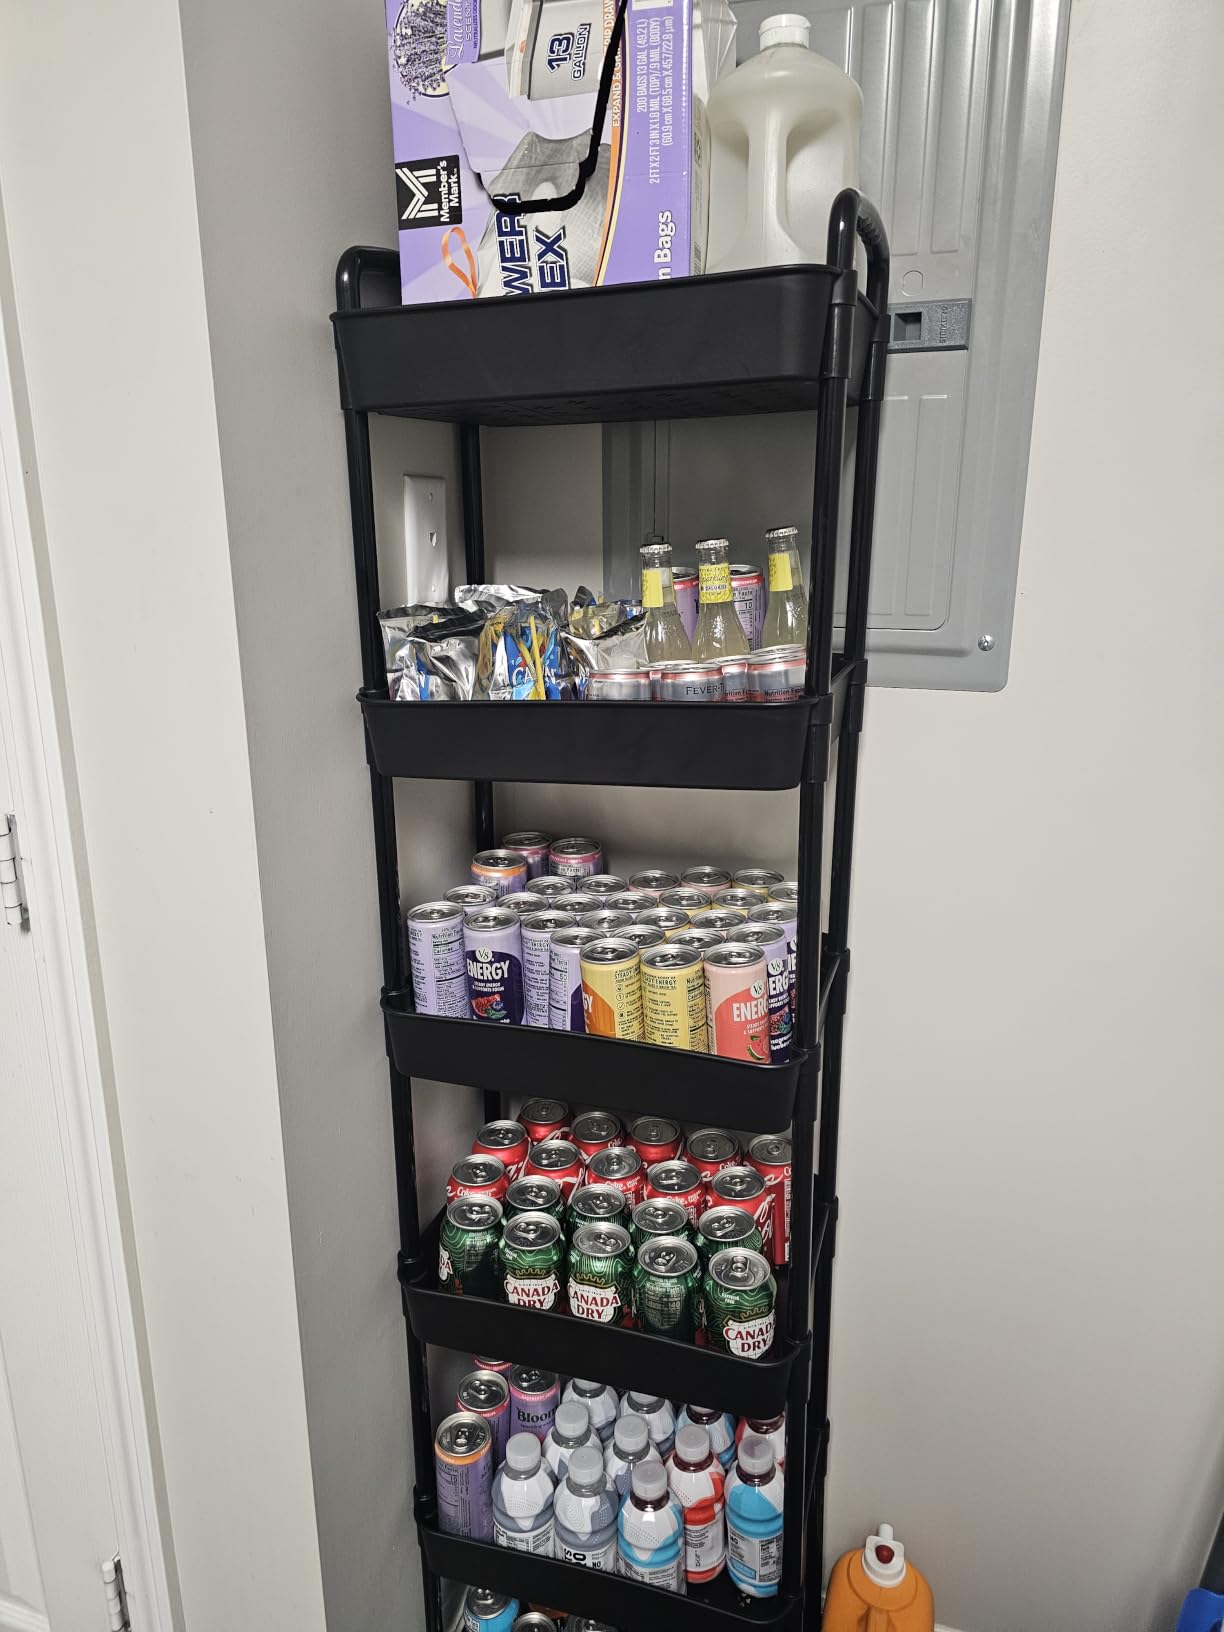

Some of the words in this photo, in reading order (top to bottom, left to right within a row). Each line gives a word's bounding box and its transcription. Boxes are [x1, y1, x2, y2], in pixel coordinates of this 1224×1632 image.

[546, 33, 574, 73] 13
[571, 23, 592, 81] GALLON
[637, 49, 647, 65] GAL
[650, 46, 660, 62] MIL
[637, 75, 647, 96] BAGS
[612, 83, 621, 127] EXPAND
[637, 97, 647, 112] 200
[650, 96, 660, 111] MIL
[438, 160, 450, 222] Member's
[654, 210, 676, 263] Bags
[744, 601, 753, 609] 10
[478, 948, 489, 960] V8
[466, 958, 510, 980] ENERGY
[770, 960, 781, 972] V8
[753, 982, 763, 995] V8
[504, 1280, 559, 1298] CANADA
[568, 1283, 620, 1308] CANADA
[576, 1303, 605, 1320] DRY
[740, 1337, 769, 1353] DRY
